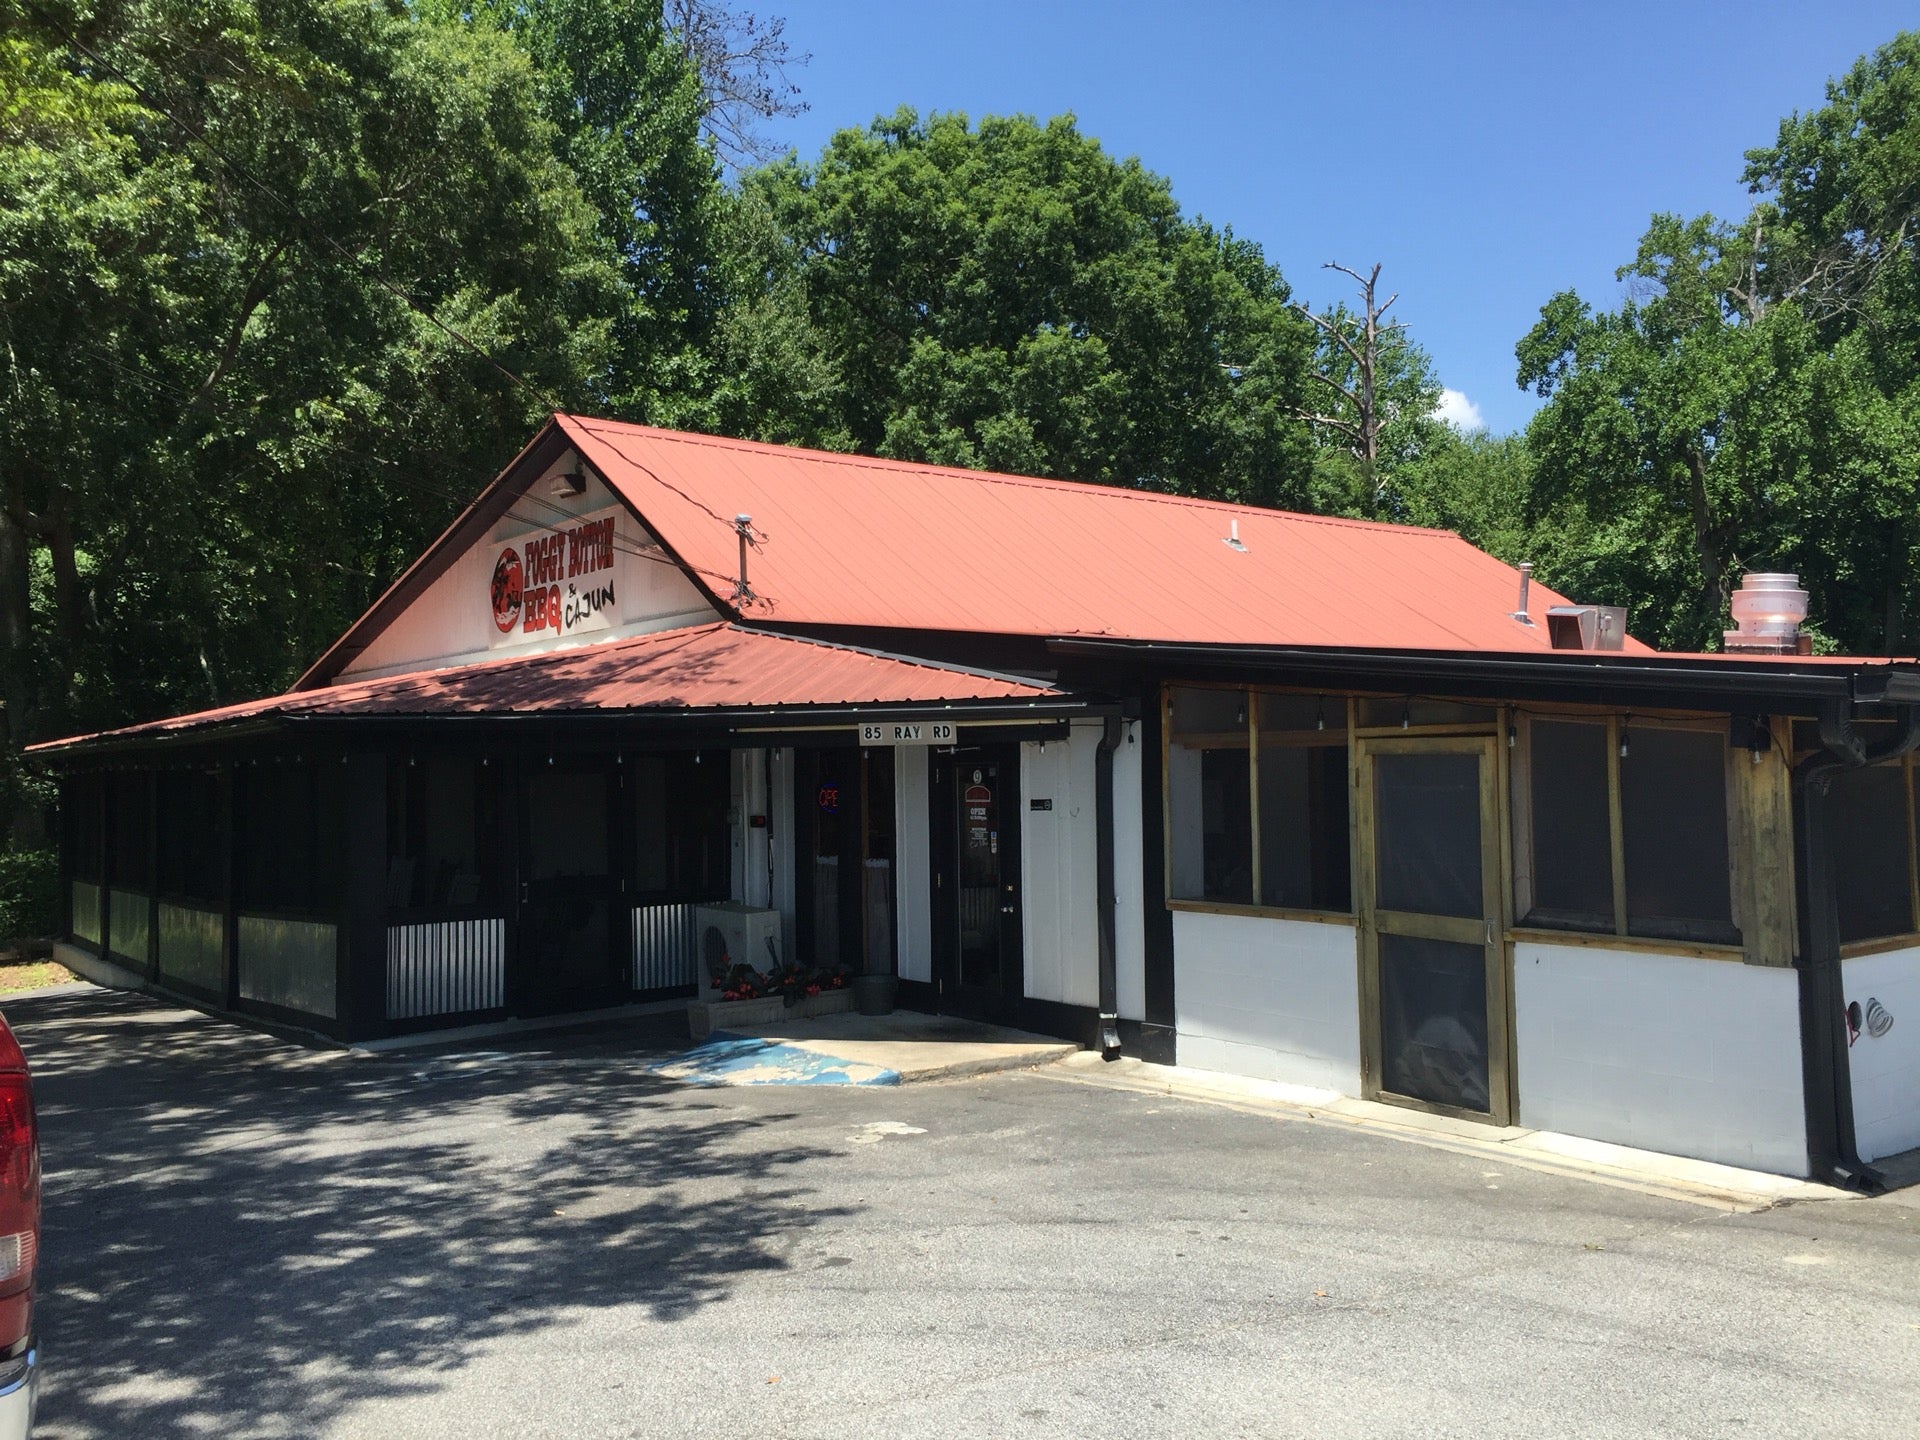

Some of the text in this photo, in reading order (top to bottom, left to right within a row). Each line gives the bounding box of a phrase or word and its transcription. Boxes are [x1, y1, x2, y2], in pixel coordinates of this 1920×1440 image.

[525, 516, 615, 588] FOGGY BOTTOM
[523, 579, 616, 636] BBQ & CAJUN
[864, 725, 951, 739] 85 RAY RD
[818, 789, 839, 807] OPE
